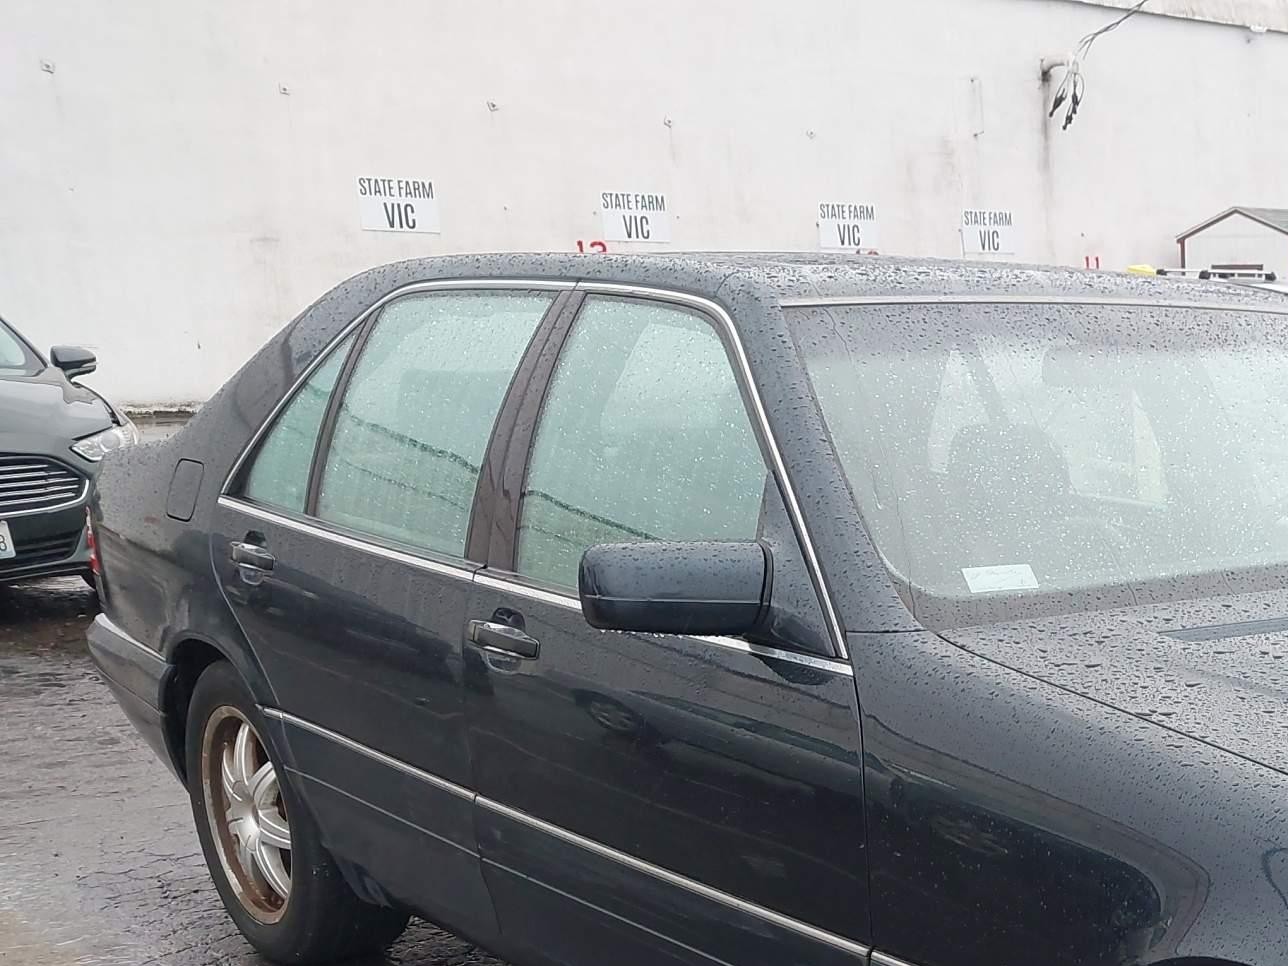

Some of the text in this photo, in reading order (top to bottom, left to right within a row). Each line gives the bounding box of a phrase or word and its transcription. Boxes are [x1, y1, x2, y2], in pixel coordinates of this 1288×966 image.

[358, 177, 434, 199] STATE FARM
[601, 192, 666, 211] STATE FARM
[819, 203, 875, 220] STATE FARM
[383, 202, 416, 229] VIC
[622, 214, 650, 239] VIC
[964, 210, 1012, 226] STATE FARM
[837, 223, 861, 246] VIC
[979, 229, 1000, 251] VIC
[1085, 255, 1099, 269] 11
